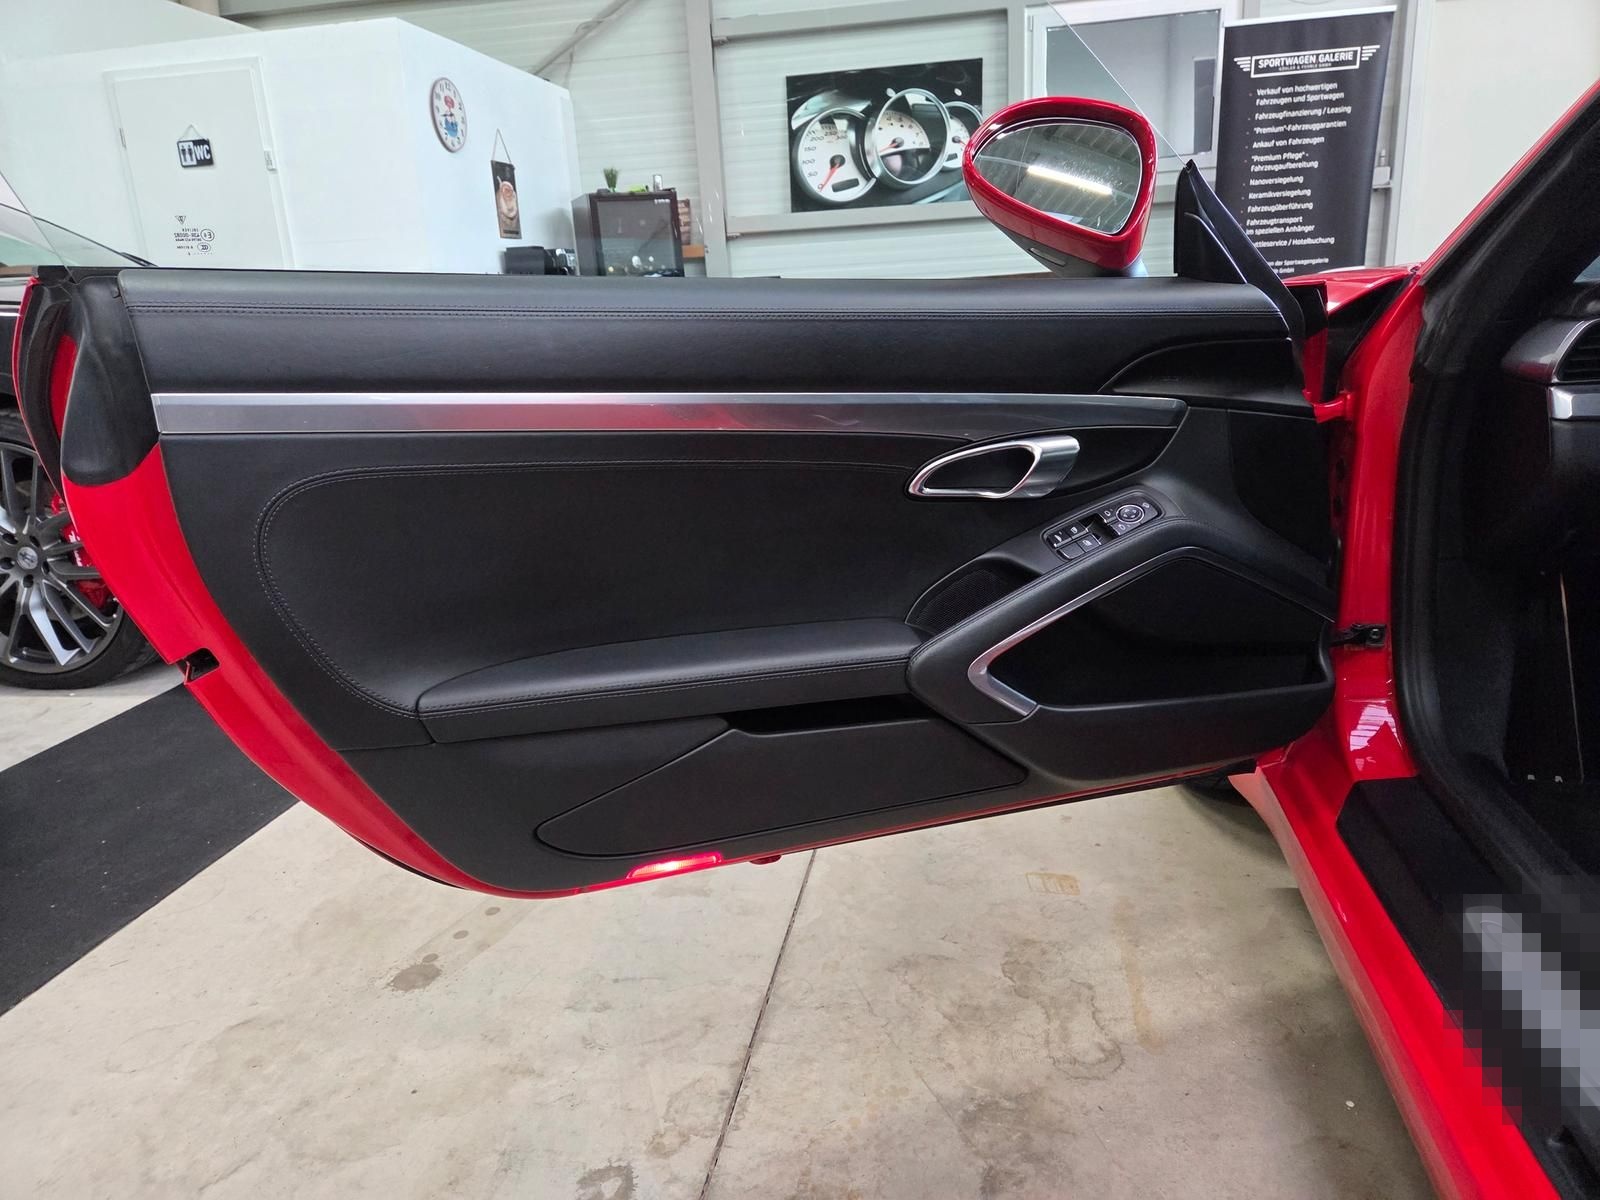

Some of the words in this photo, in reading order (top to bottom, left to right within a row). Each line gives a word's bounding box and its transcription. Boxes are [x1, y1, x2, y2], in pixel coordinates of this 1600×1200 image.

[1258, 54, 1316, 69] SPORTWAGEN
[1318, 51, 1354, 63] GALERIE
[1256, 86, 1281, 96] Verkauf
[1282, 86, 1294, 94] von
[1294, 82, 1338, 93] hochwertigen
[1256, 97, 1292, 106] Fahrzeugen
[1293, 95, 1306, 103] und
[1306, 92, 1345, 102] Sportwagen
[1254, 108, 1322, 121] Fahrzeugfinanzierung
[1327, 106, 1352, 115] Leasing
[1252, 139, 1276, 149] Ankauf
[1288, 136, 1325, 146] Fahrzeugen
[194, 144, 211, 161] WC
[1250, 160, 1319, 173] Fahrzeugaufbereitung
[1249, 175, 1304, 186] Nanoversiegelung
[1248, 189, 1312, 200] Keramikversiegelung
[1247, 201, 1314, 213] Fahrzeugüberführung
[1246, 216, 1303, 227] Fahrzeugtransport
[1285, 224, 1315, 234] Anhänger
[1292, 236, 1335, 246] Hotelbuchung
